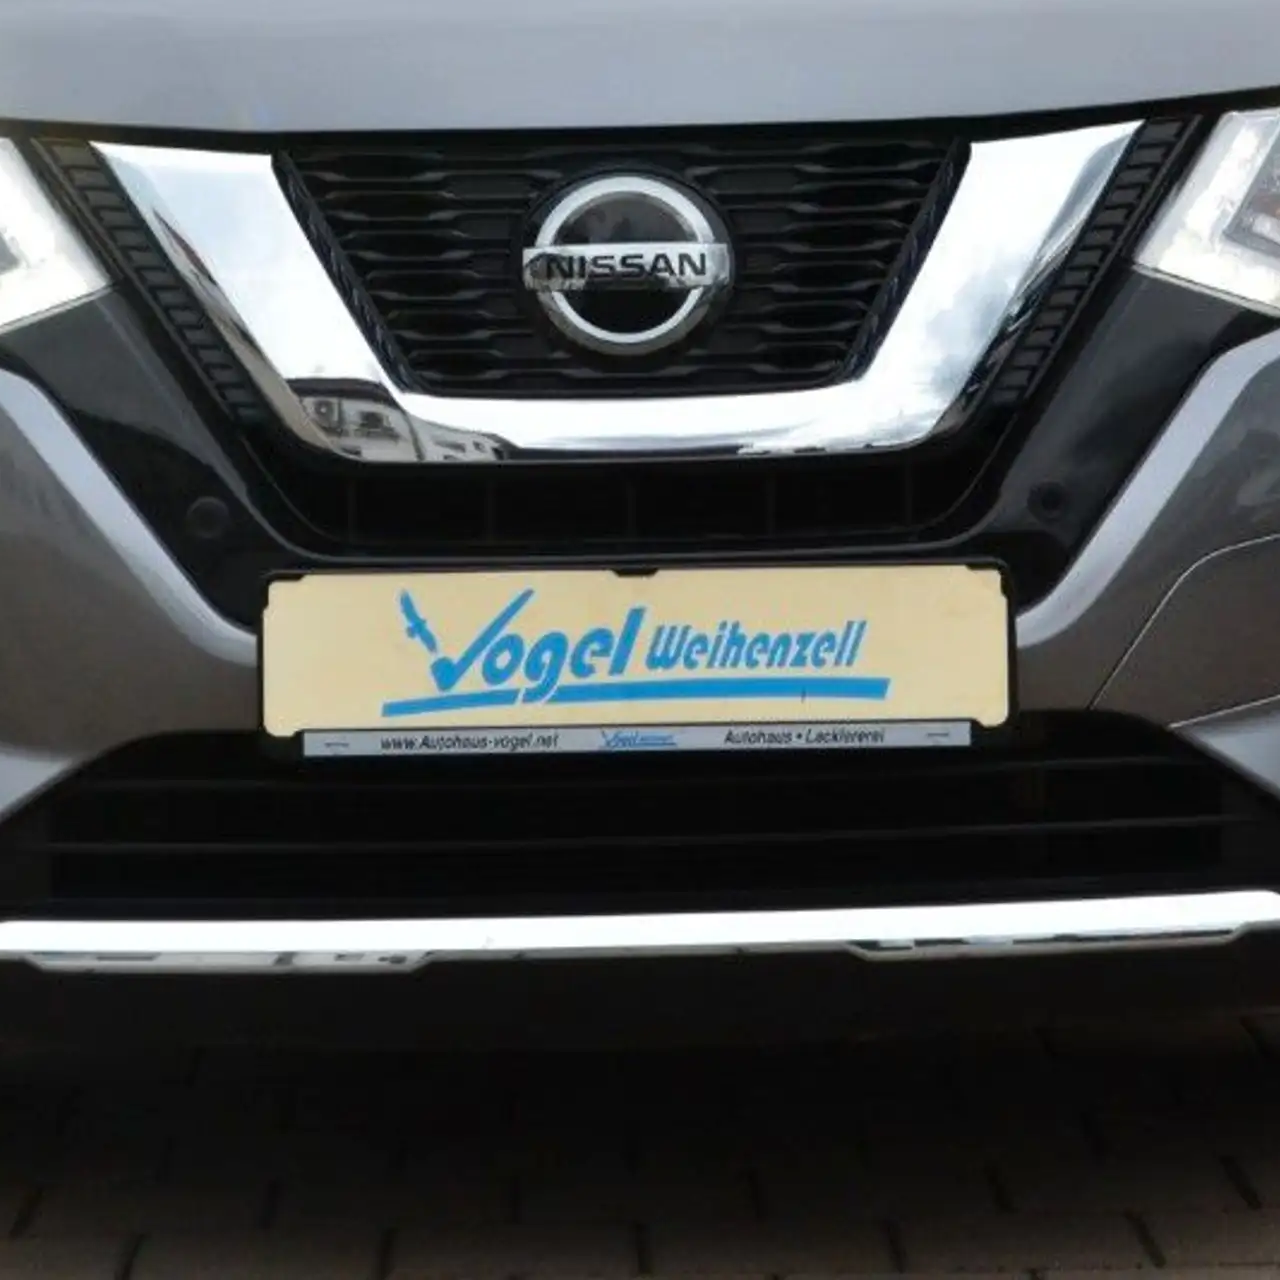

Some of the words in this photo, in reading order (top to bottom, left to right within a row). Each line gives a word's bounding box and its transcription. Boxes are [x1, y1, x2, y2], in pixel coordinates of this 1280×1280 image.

[545, 252, 707, 280] NISSAN
[400, 588, 647, 704] Vogel
[645, 620, 867, 670] Weihenzell
[723, 728, 793, 745] Autohaus
